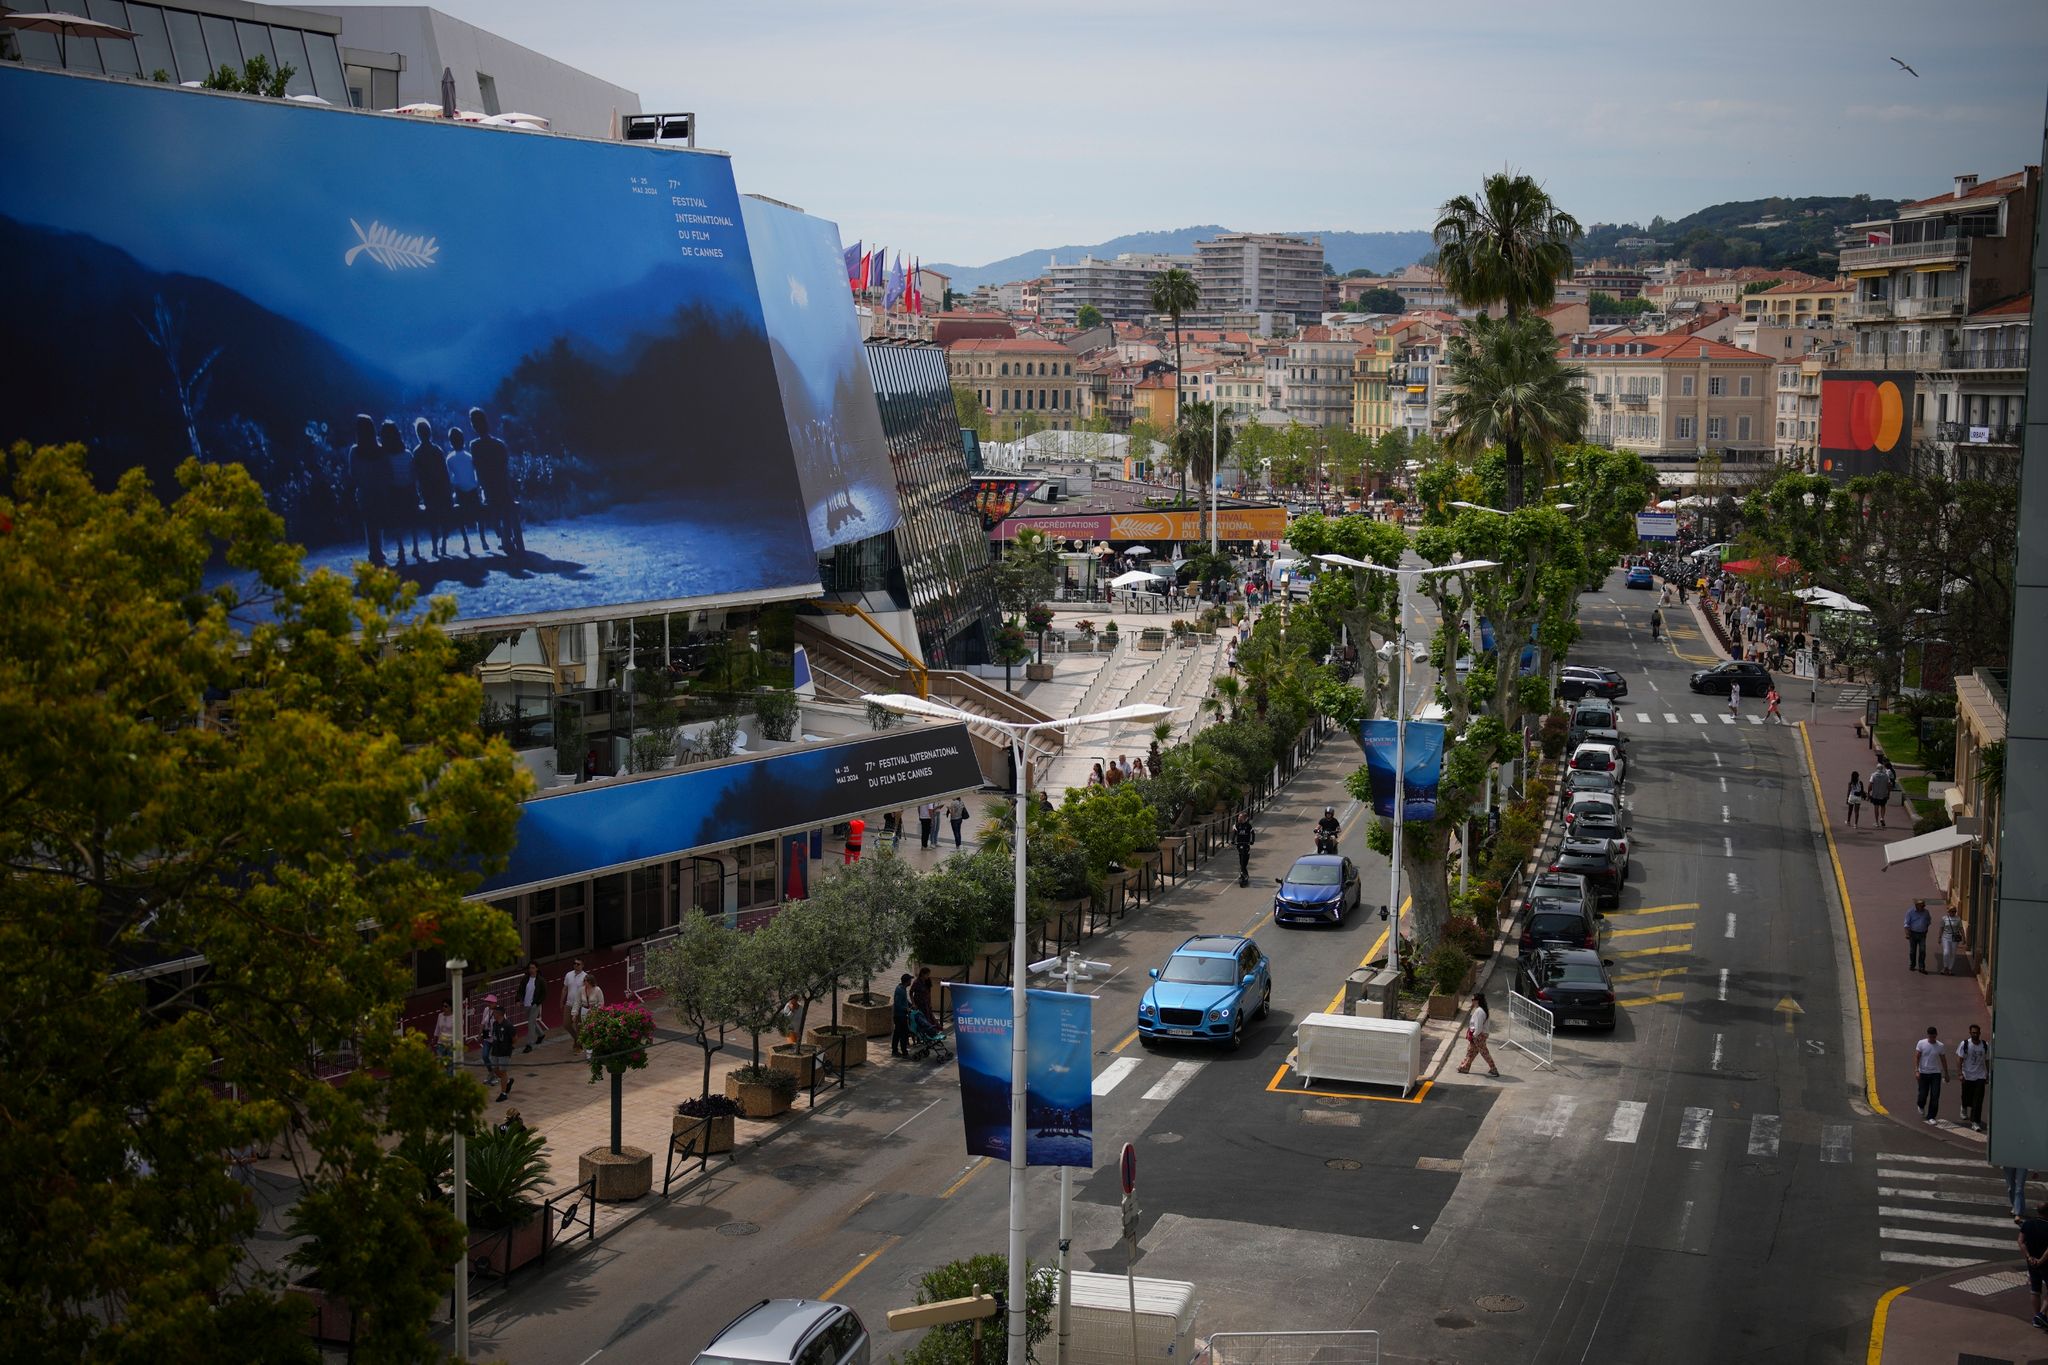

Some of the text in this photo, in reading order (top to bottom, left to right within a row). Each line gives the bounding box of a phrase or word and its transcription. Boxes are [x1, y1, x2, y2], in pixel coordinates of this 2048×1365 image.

[672, 196, 708, 208] FESTIVAL
[676, 214, 734, 226] INTERNATIONAL
[679, 230, 710, 240] DU FILM
[682, 246, 724, 258] DE CANNES
[879, 756, 909, 768] FESTIVAL
[910, 746, 958, 763] INTERNATIONAL
[868, 767, 933, 788] DU FILM DE CANNES
[958, 1016, 1012, 1028] BIENVENUE
